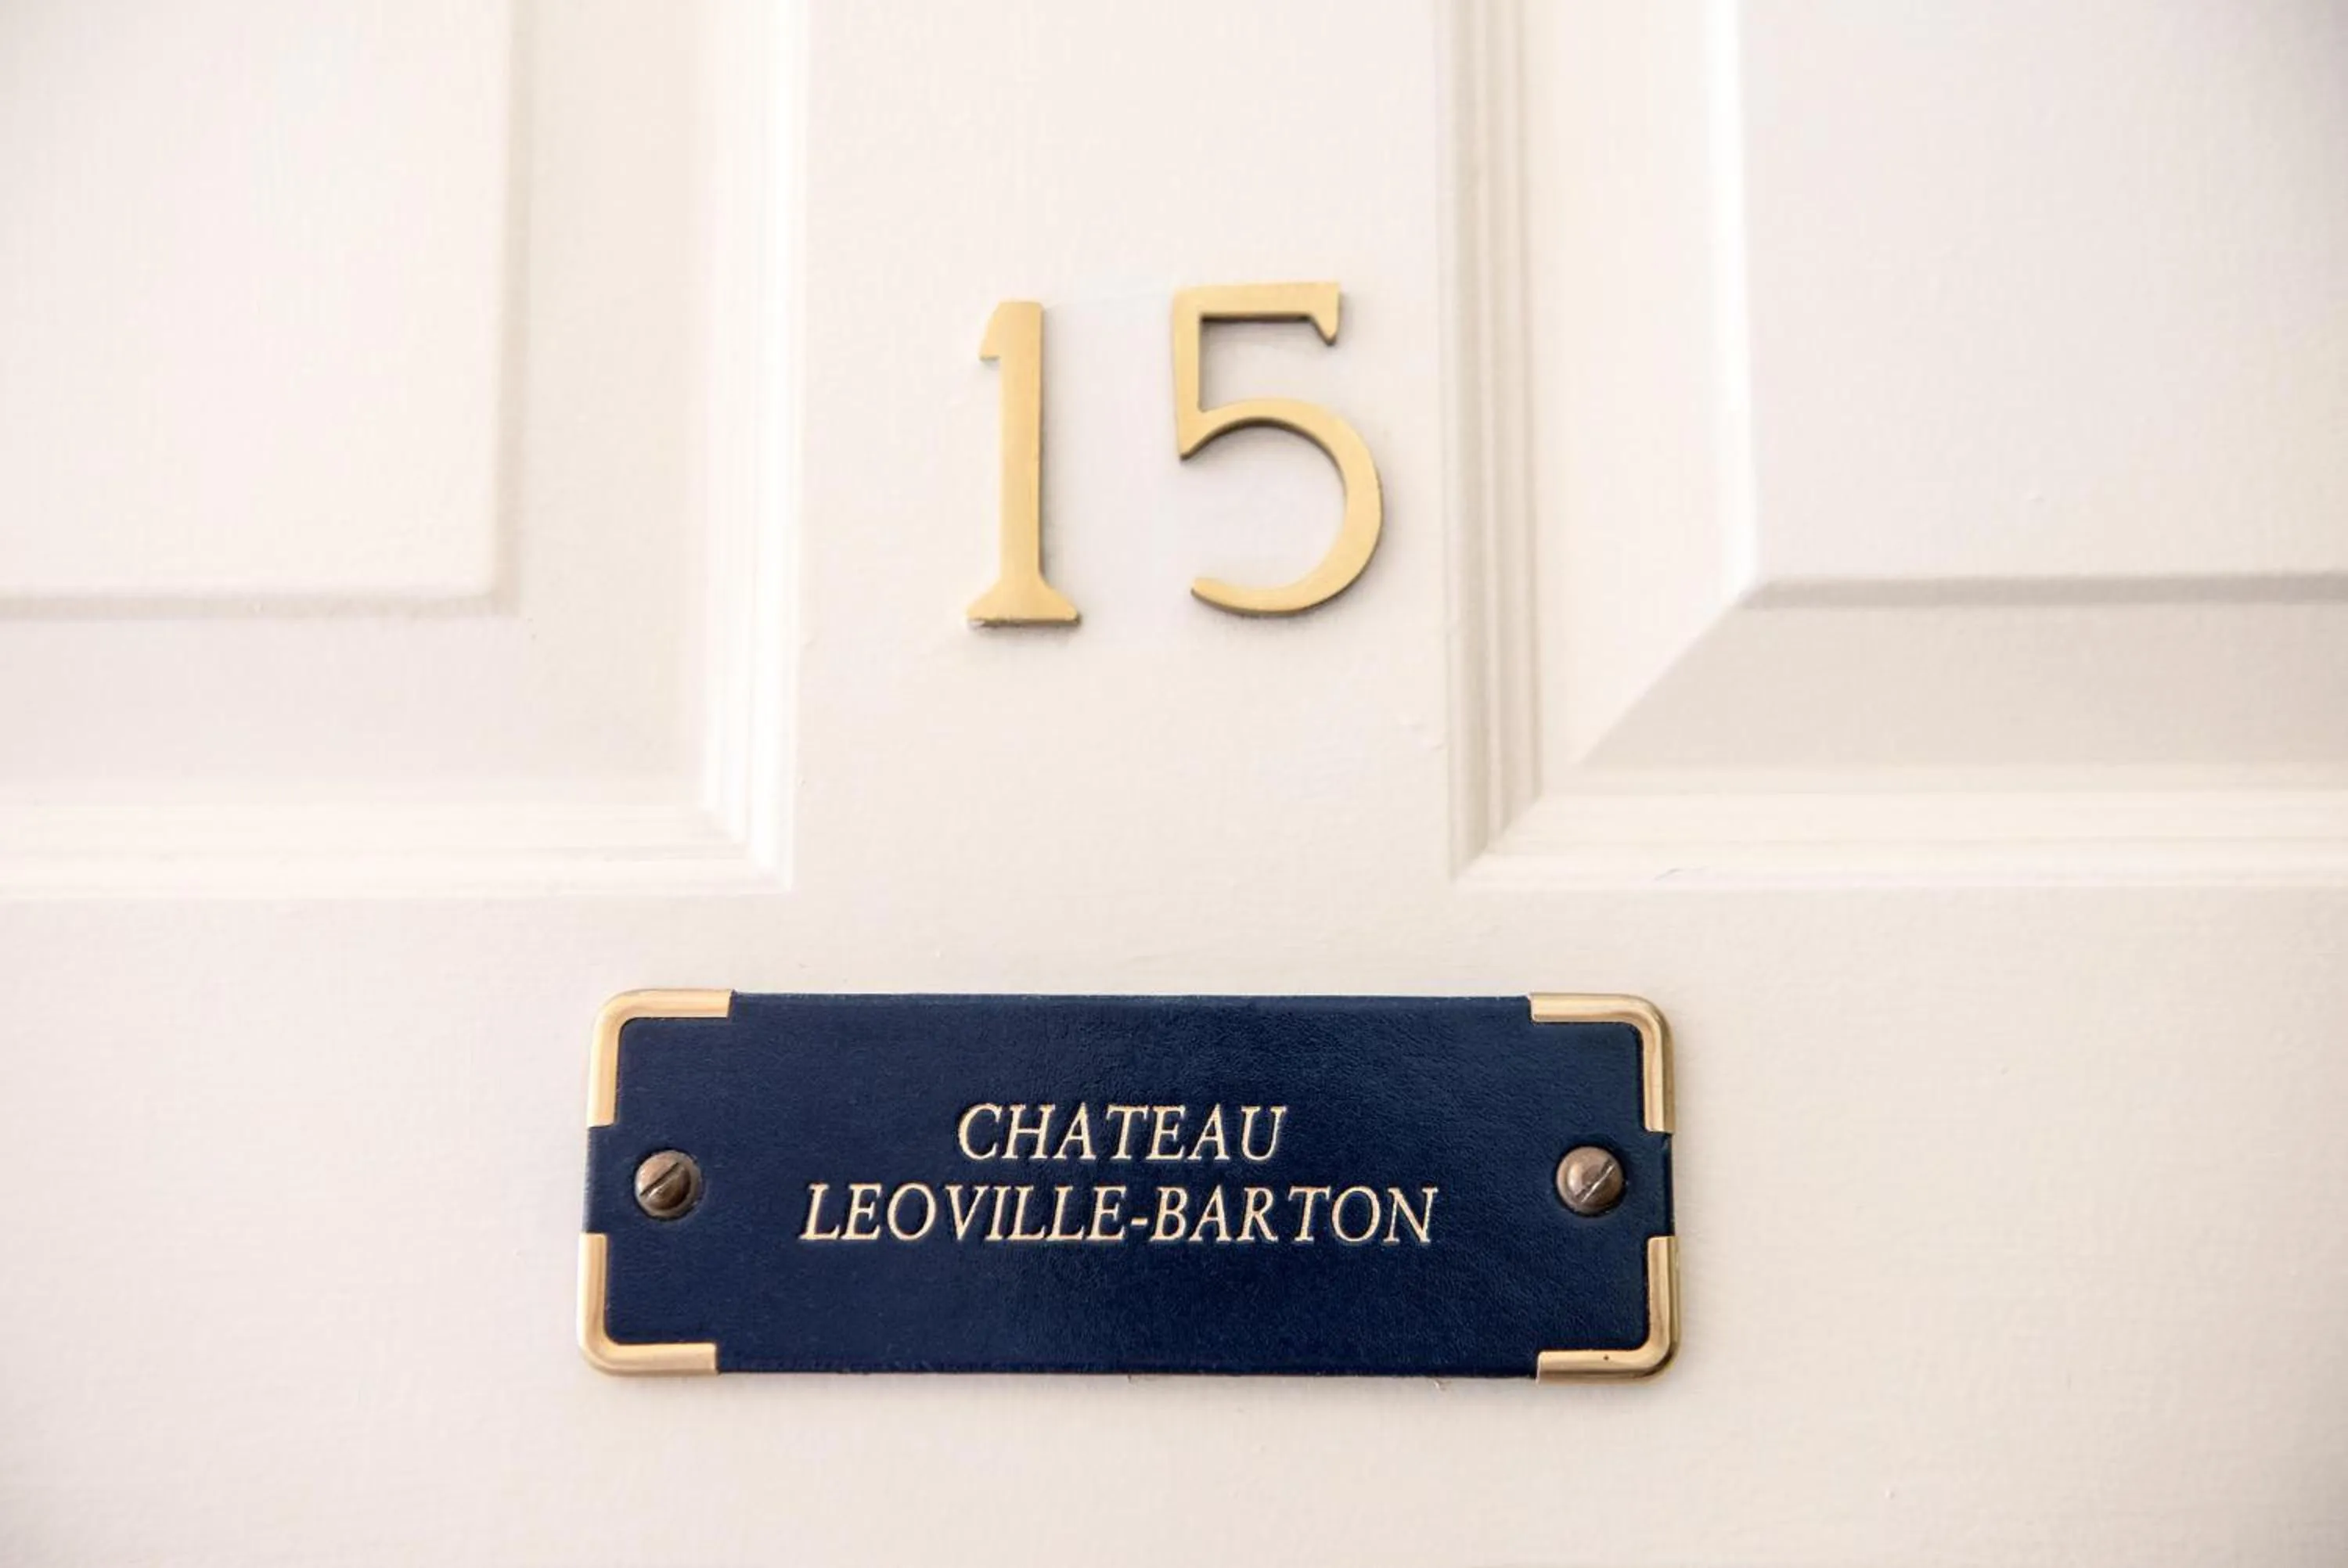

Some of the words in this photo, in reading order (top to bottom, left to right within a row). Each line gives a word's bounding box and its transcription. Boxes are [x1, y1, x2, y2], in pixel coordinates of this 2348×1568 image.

[966, 281, 1385, 628] 15
[956, 1101, 1288, 1162] CHATEAU
[799, 1181, 1439, 1244] LEOVILLE-BARTON
